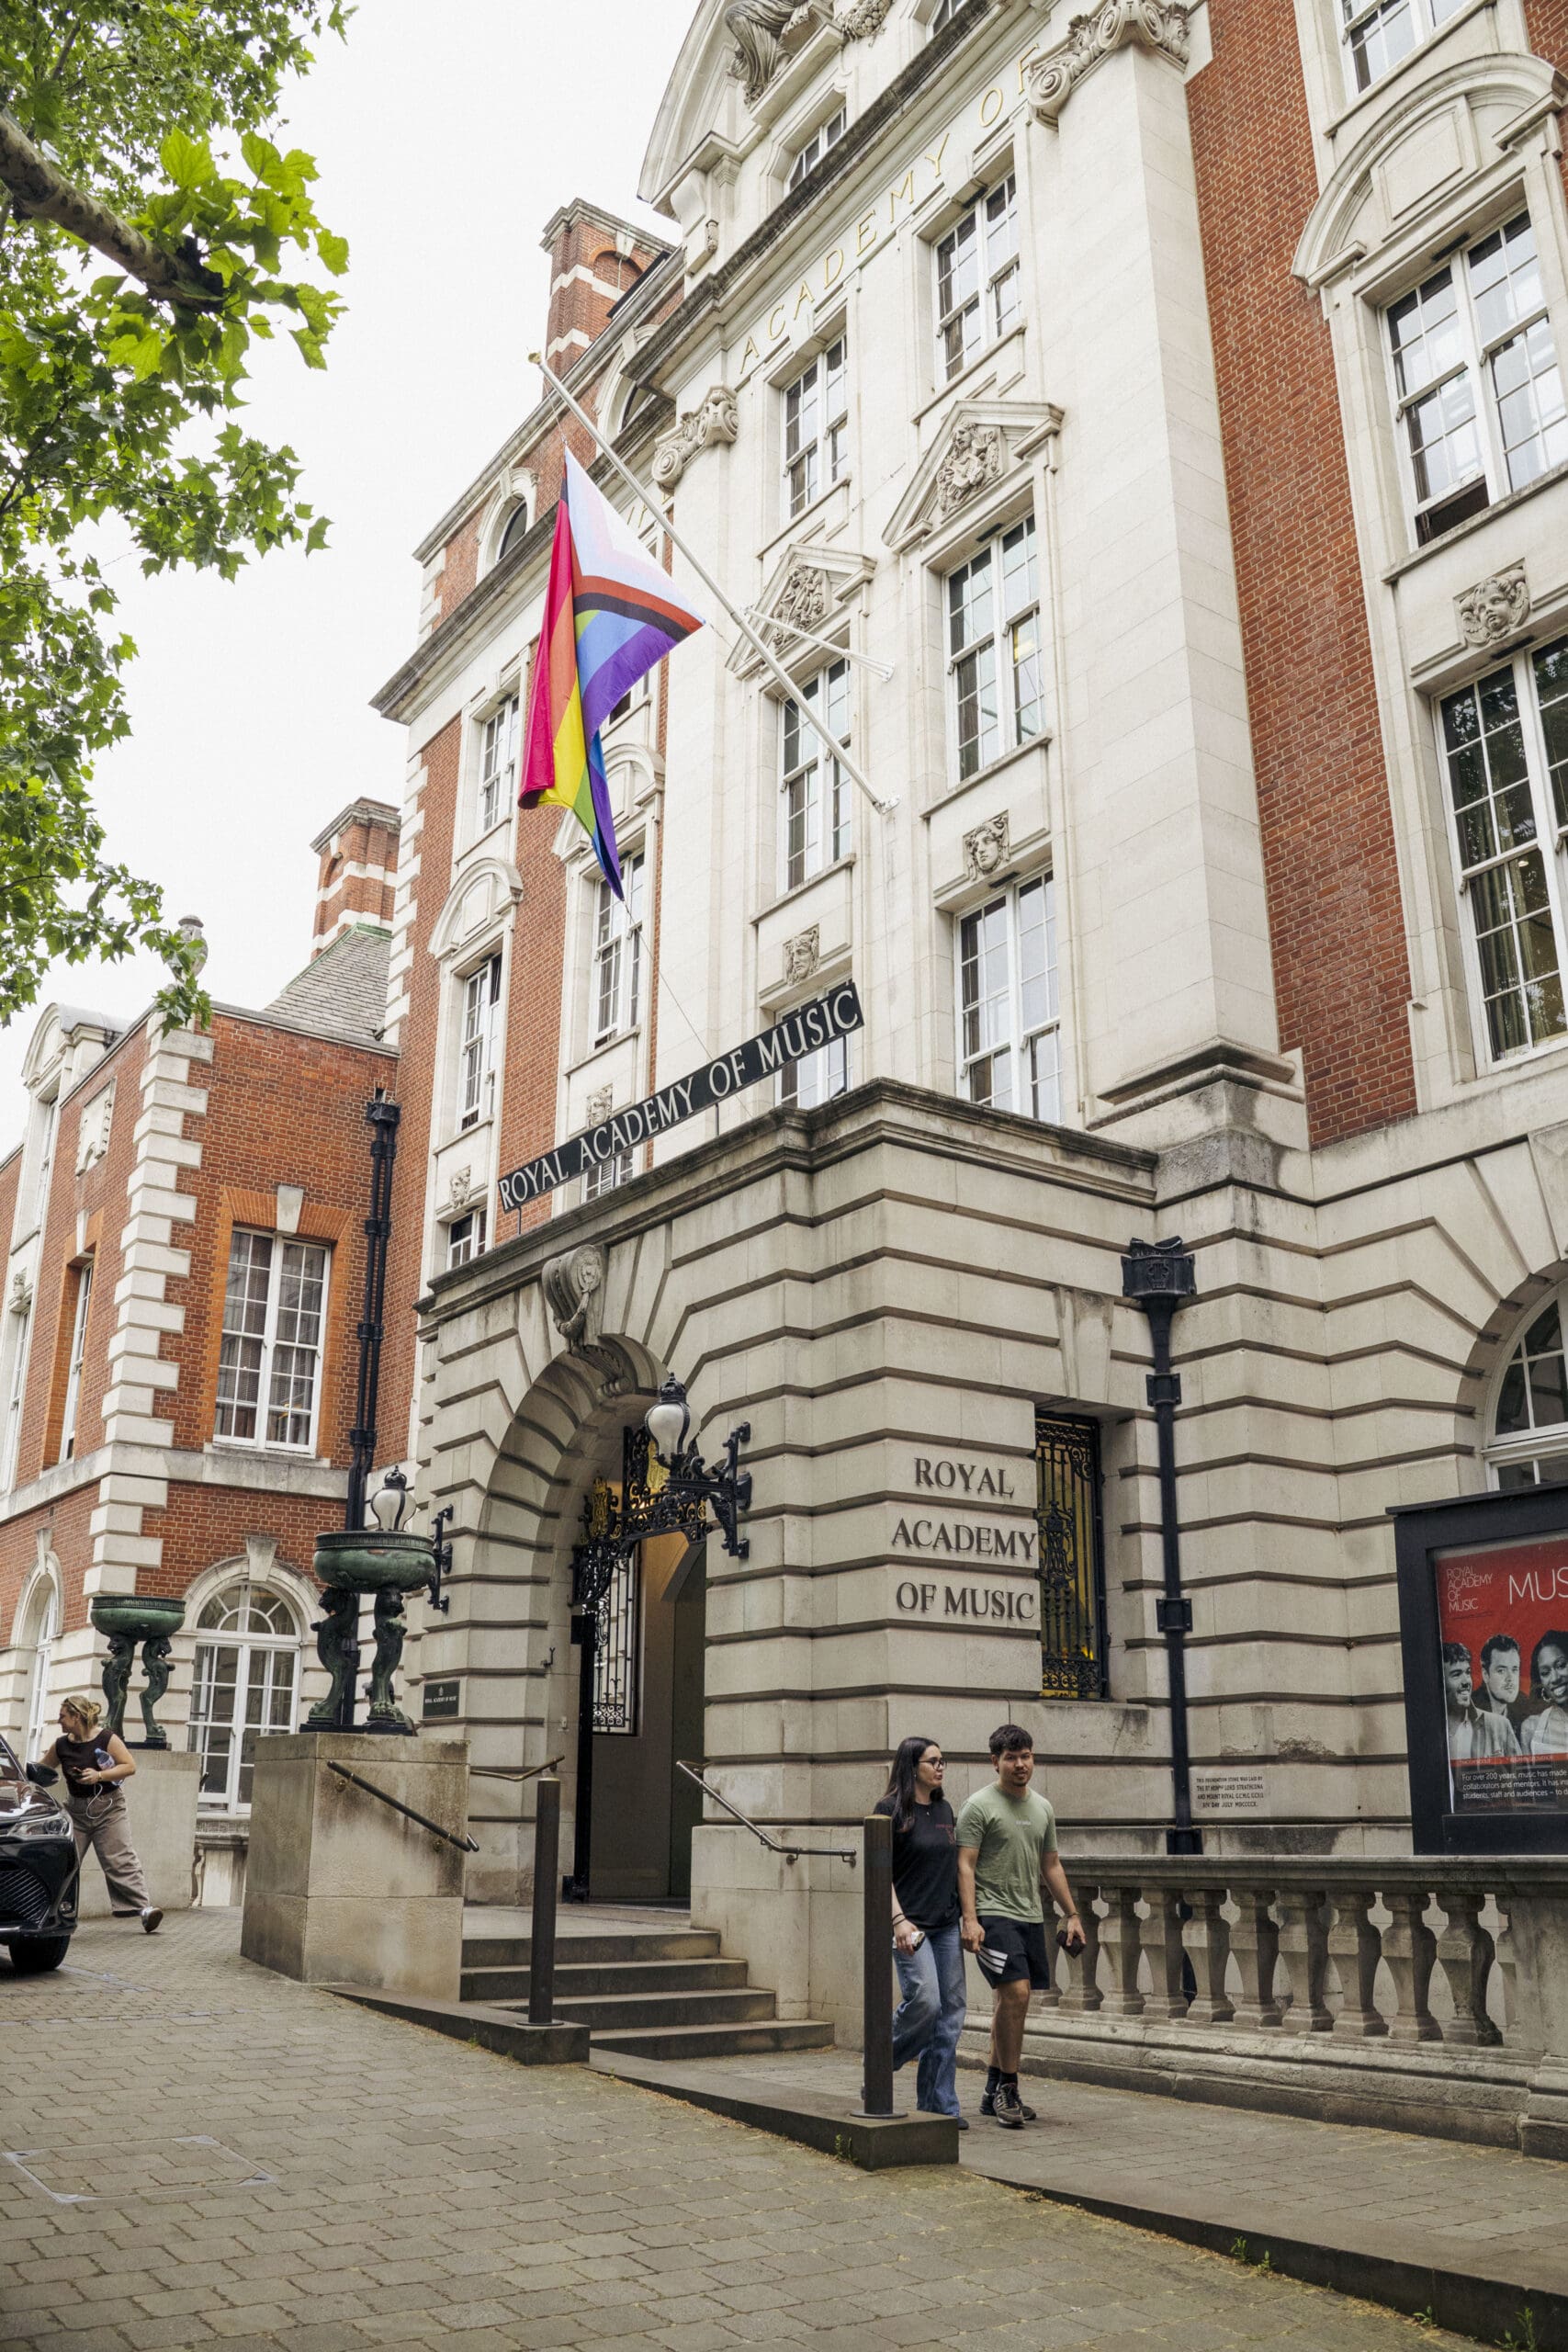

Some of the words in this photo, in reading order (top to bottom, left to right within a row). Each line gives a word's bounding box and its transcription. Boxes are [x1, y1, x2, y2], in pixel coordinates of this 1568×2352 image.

[738, 132, 951, 375] ACADEMY
[979, 42, 1040, 129] OF
[499, 1152, 569, 1211] ROYAL
[579, 1078, 696, 1170] ACADEMY
[709, 1050, 746, 1098] OF
[756, 989, 859, 1073] MUSIC
[913, 1457, 1015, 1498] ROYAL
[891, 1517, 1037, 1559] ACADEMY
[1447, 1566, 1476, 1580] ROYAL
[1448, 1573, 1493, 1591] ACADEMY
[896, 1581, 937, 1612] OF
[944, 1586, 1035, 1620] MUSIC
[1448, 1589, 1461, 1602] OF
[1449, 1598, 1479, 1612] MUSIC
[1486, 1772, 1497, 1781] 200
[1550, 1769, 1567, 1777] made
[1501, 1781, 1512, 1789] and
[1504, 1790, 1516, 1798] and
[1517, 1788, 1549, 1797] audiences
